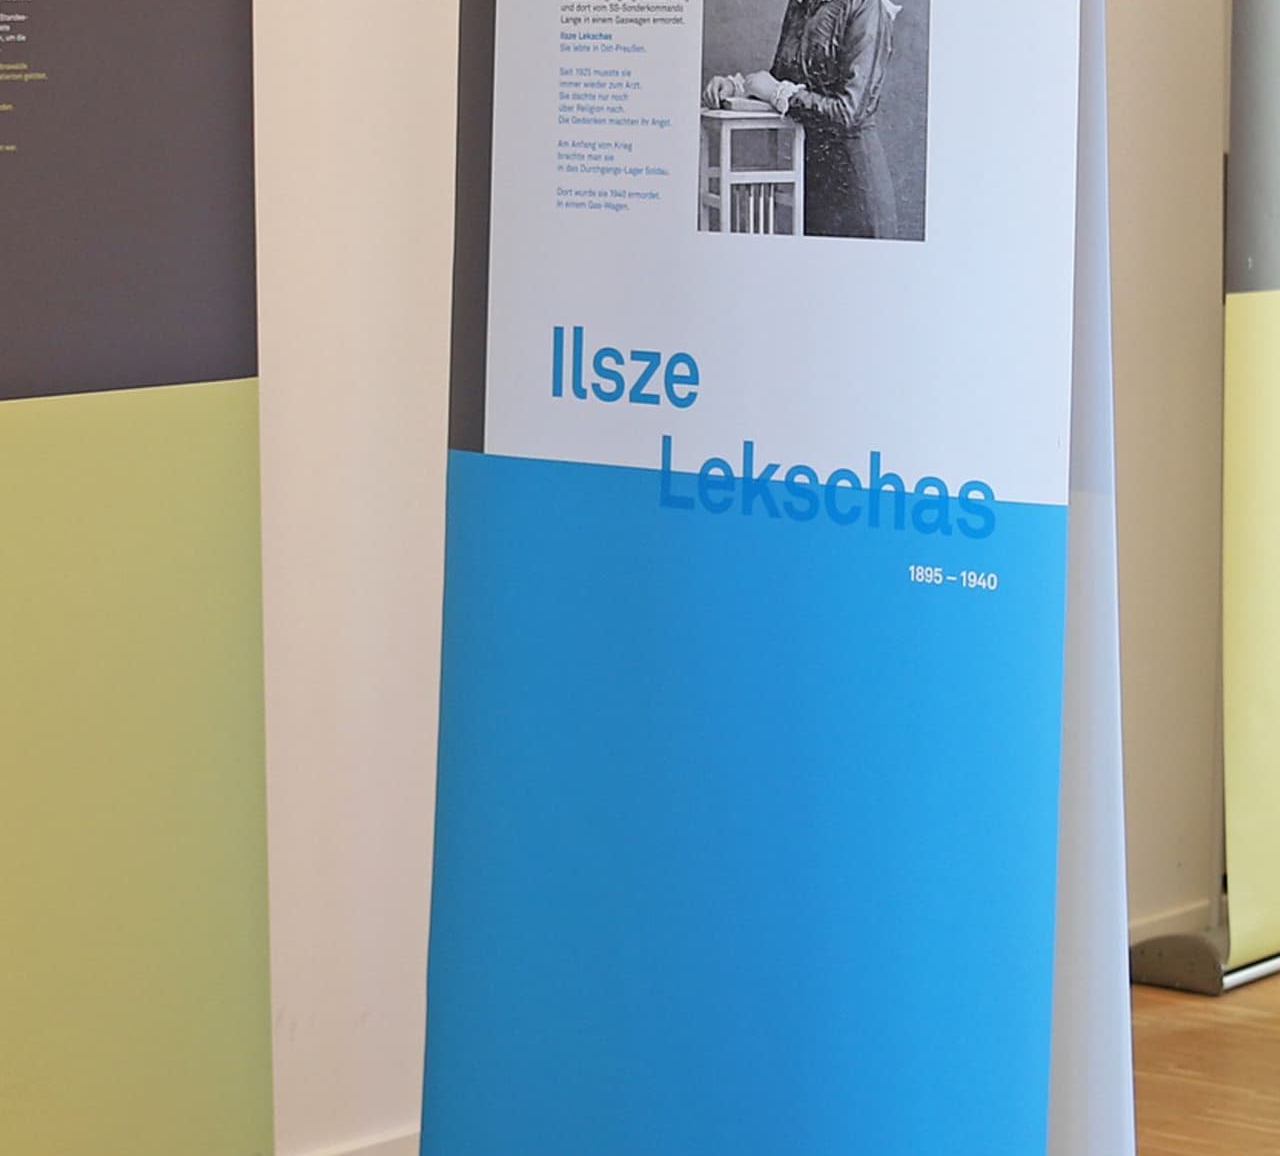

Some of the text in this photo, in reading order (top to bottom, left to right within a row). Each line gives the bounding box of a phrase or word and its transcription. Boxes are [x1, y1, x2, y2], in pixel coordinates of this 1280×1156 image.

[552, 325, 700, 409] Ilsze
[660, 435, 996, 540] Lekschas
[908, 565, 943, 585] 1895
[960, 570, 998, 591] 1940
